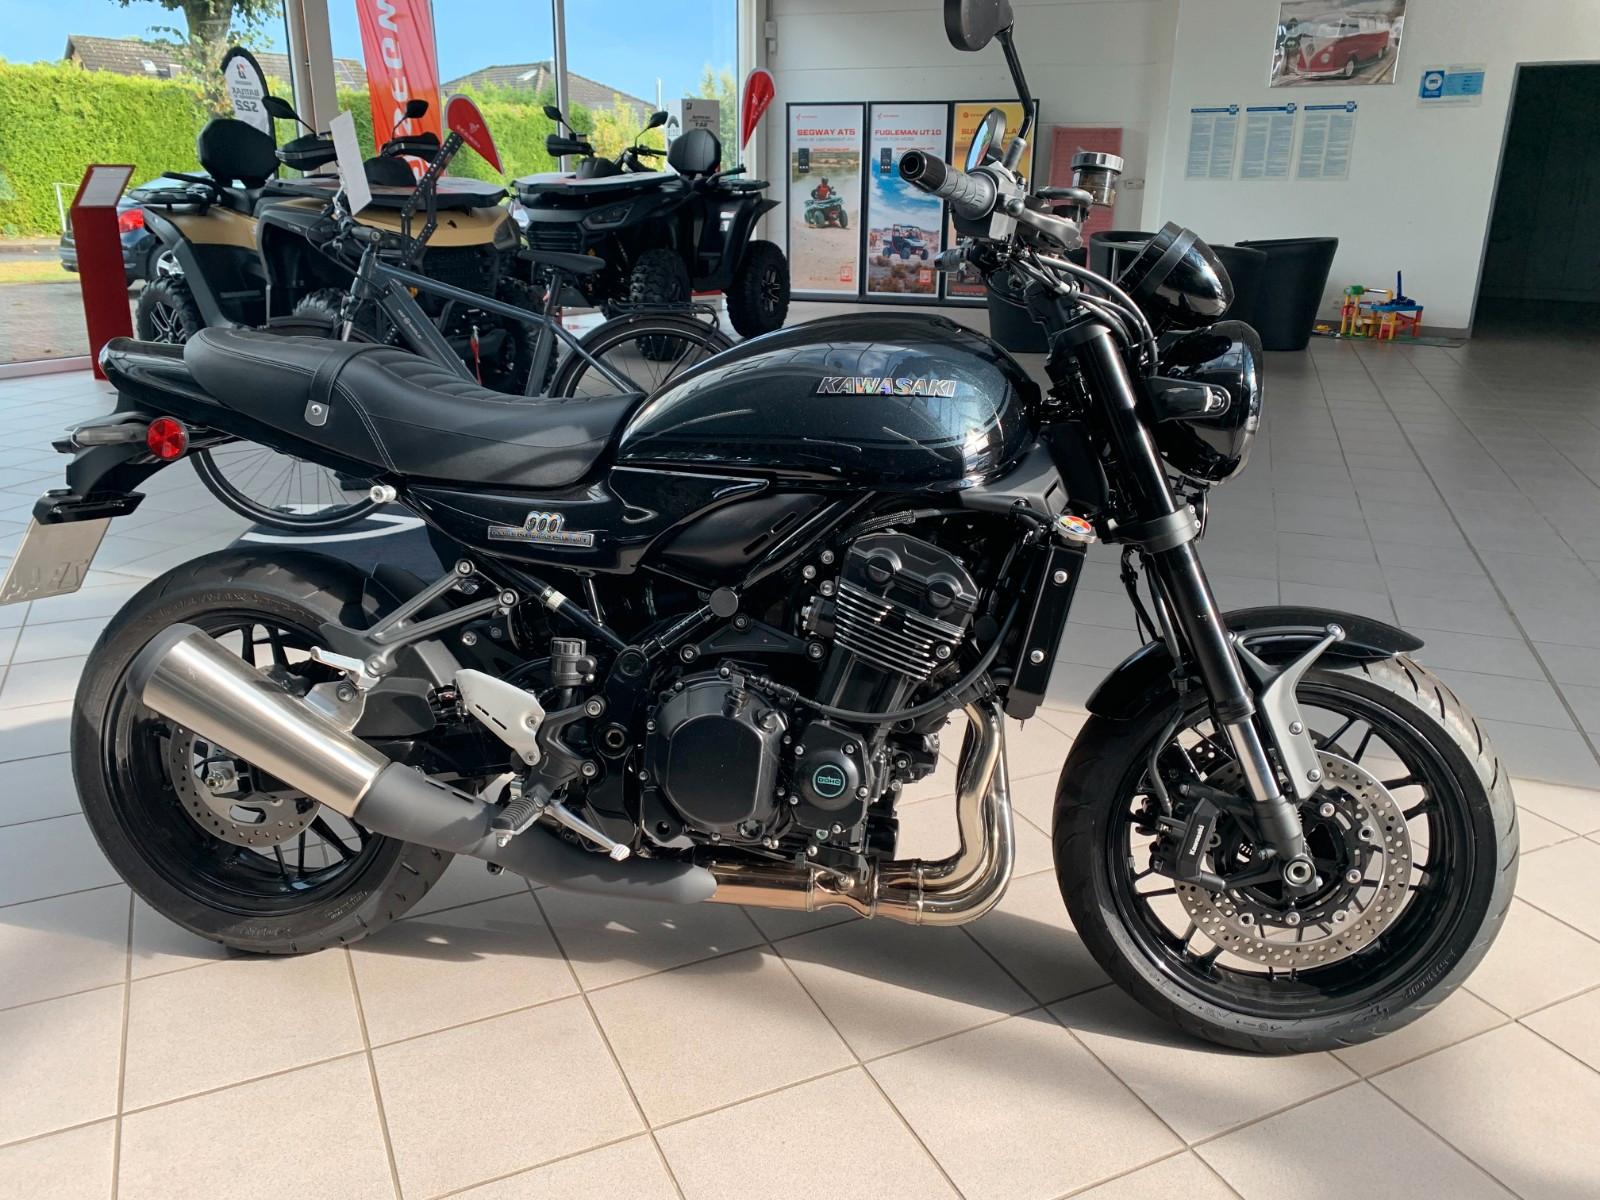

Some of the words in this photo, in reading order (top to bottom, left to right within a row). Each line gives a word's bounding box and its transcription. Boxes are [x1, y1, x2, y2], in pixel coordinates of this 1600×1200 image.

[797, 128, 836, 136] SEGWAY
[816, 376, 957, 398] KAWASAKI
[525, 513, 562, 533] 900
[818, 776, 841, 786] DOHC
